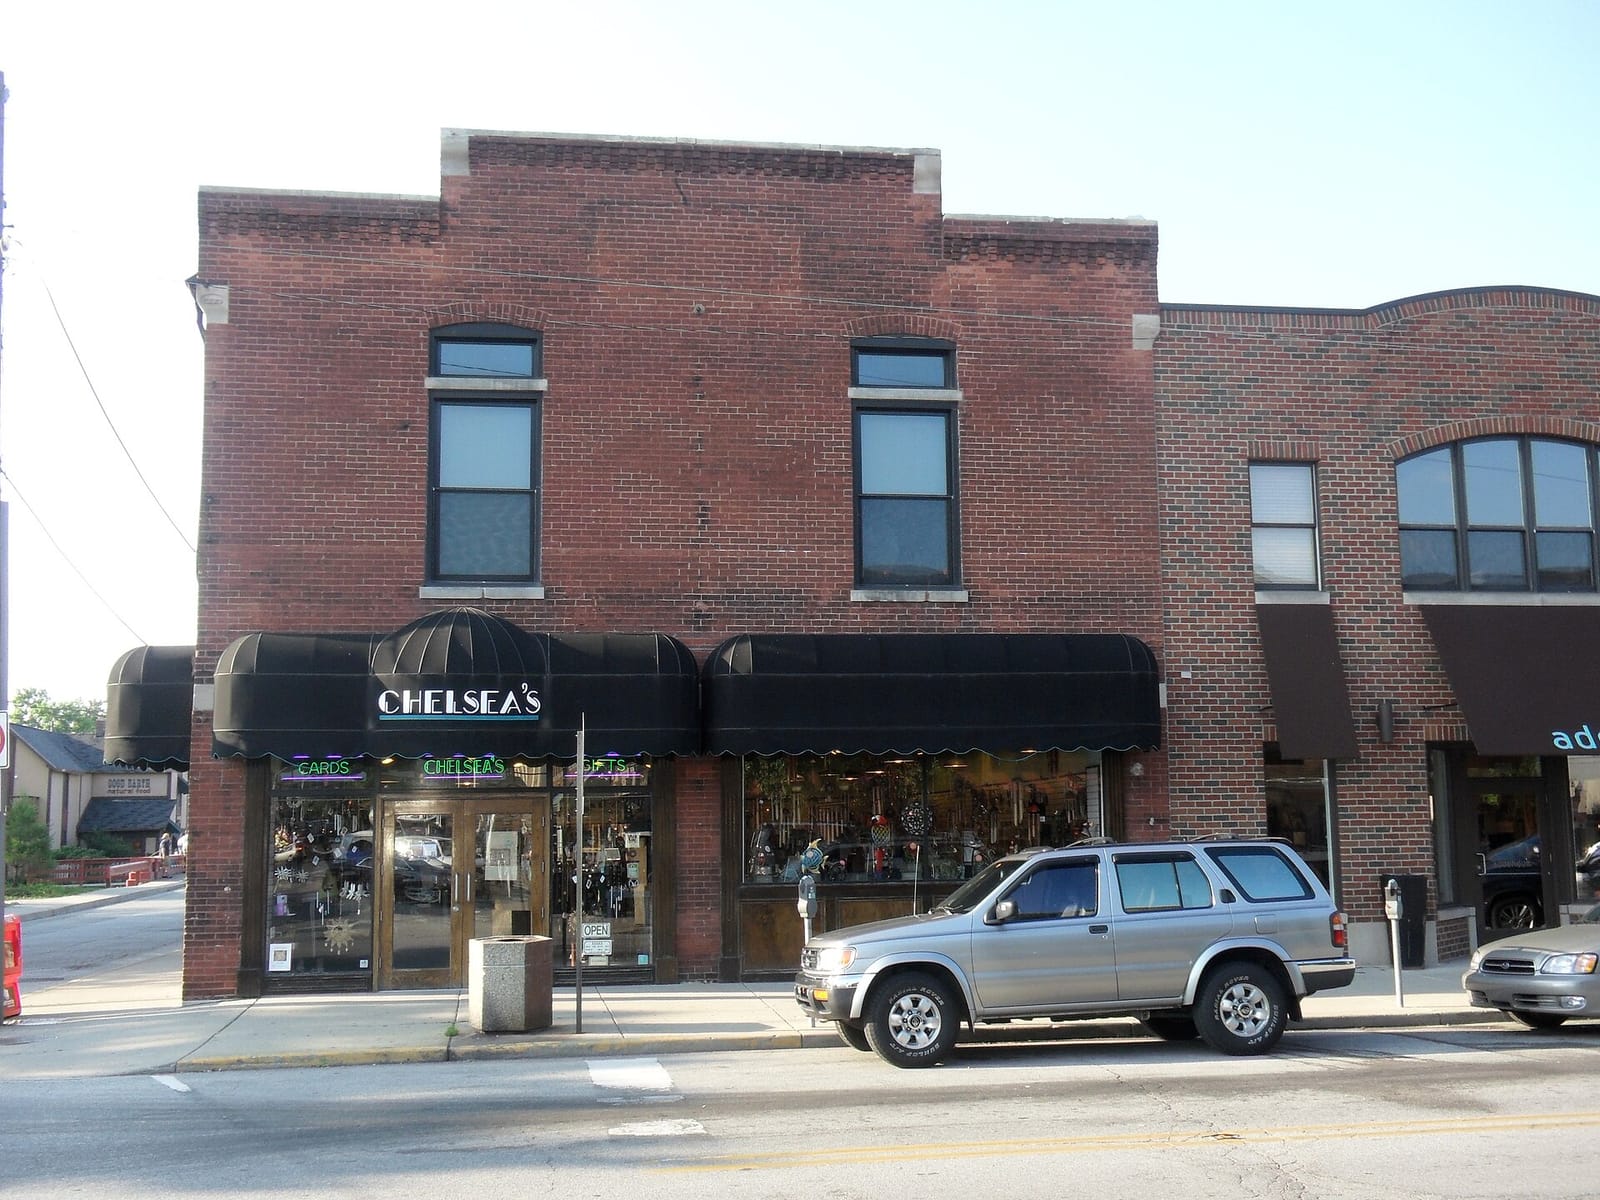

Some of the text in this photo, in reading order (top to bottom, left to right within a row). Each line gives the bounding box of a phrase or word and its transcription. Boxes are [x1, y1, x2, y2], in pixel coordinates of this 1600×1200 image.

[378, 682, 541, 714] CHELSEA'S
[1551, 724, 1600, 750] ad
[298, 761, 350, 775] CARDS
[423, 755, 505, 775] CHELSEA'S
[584, 925, 608, 936] OPEN
